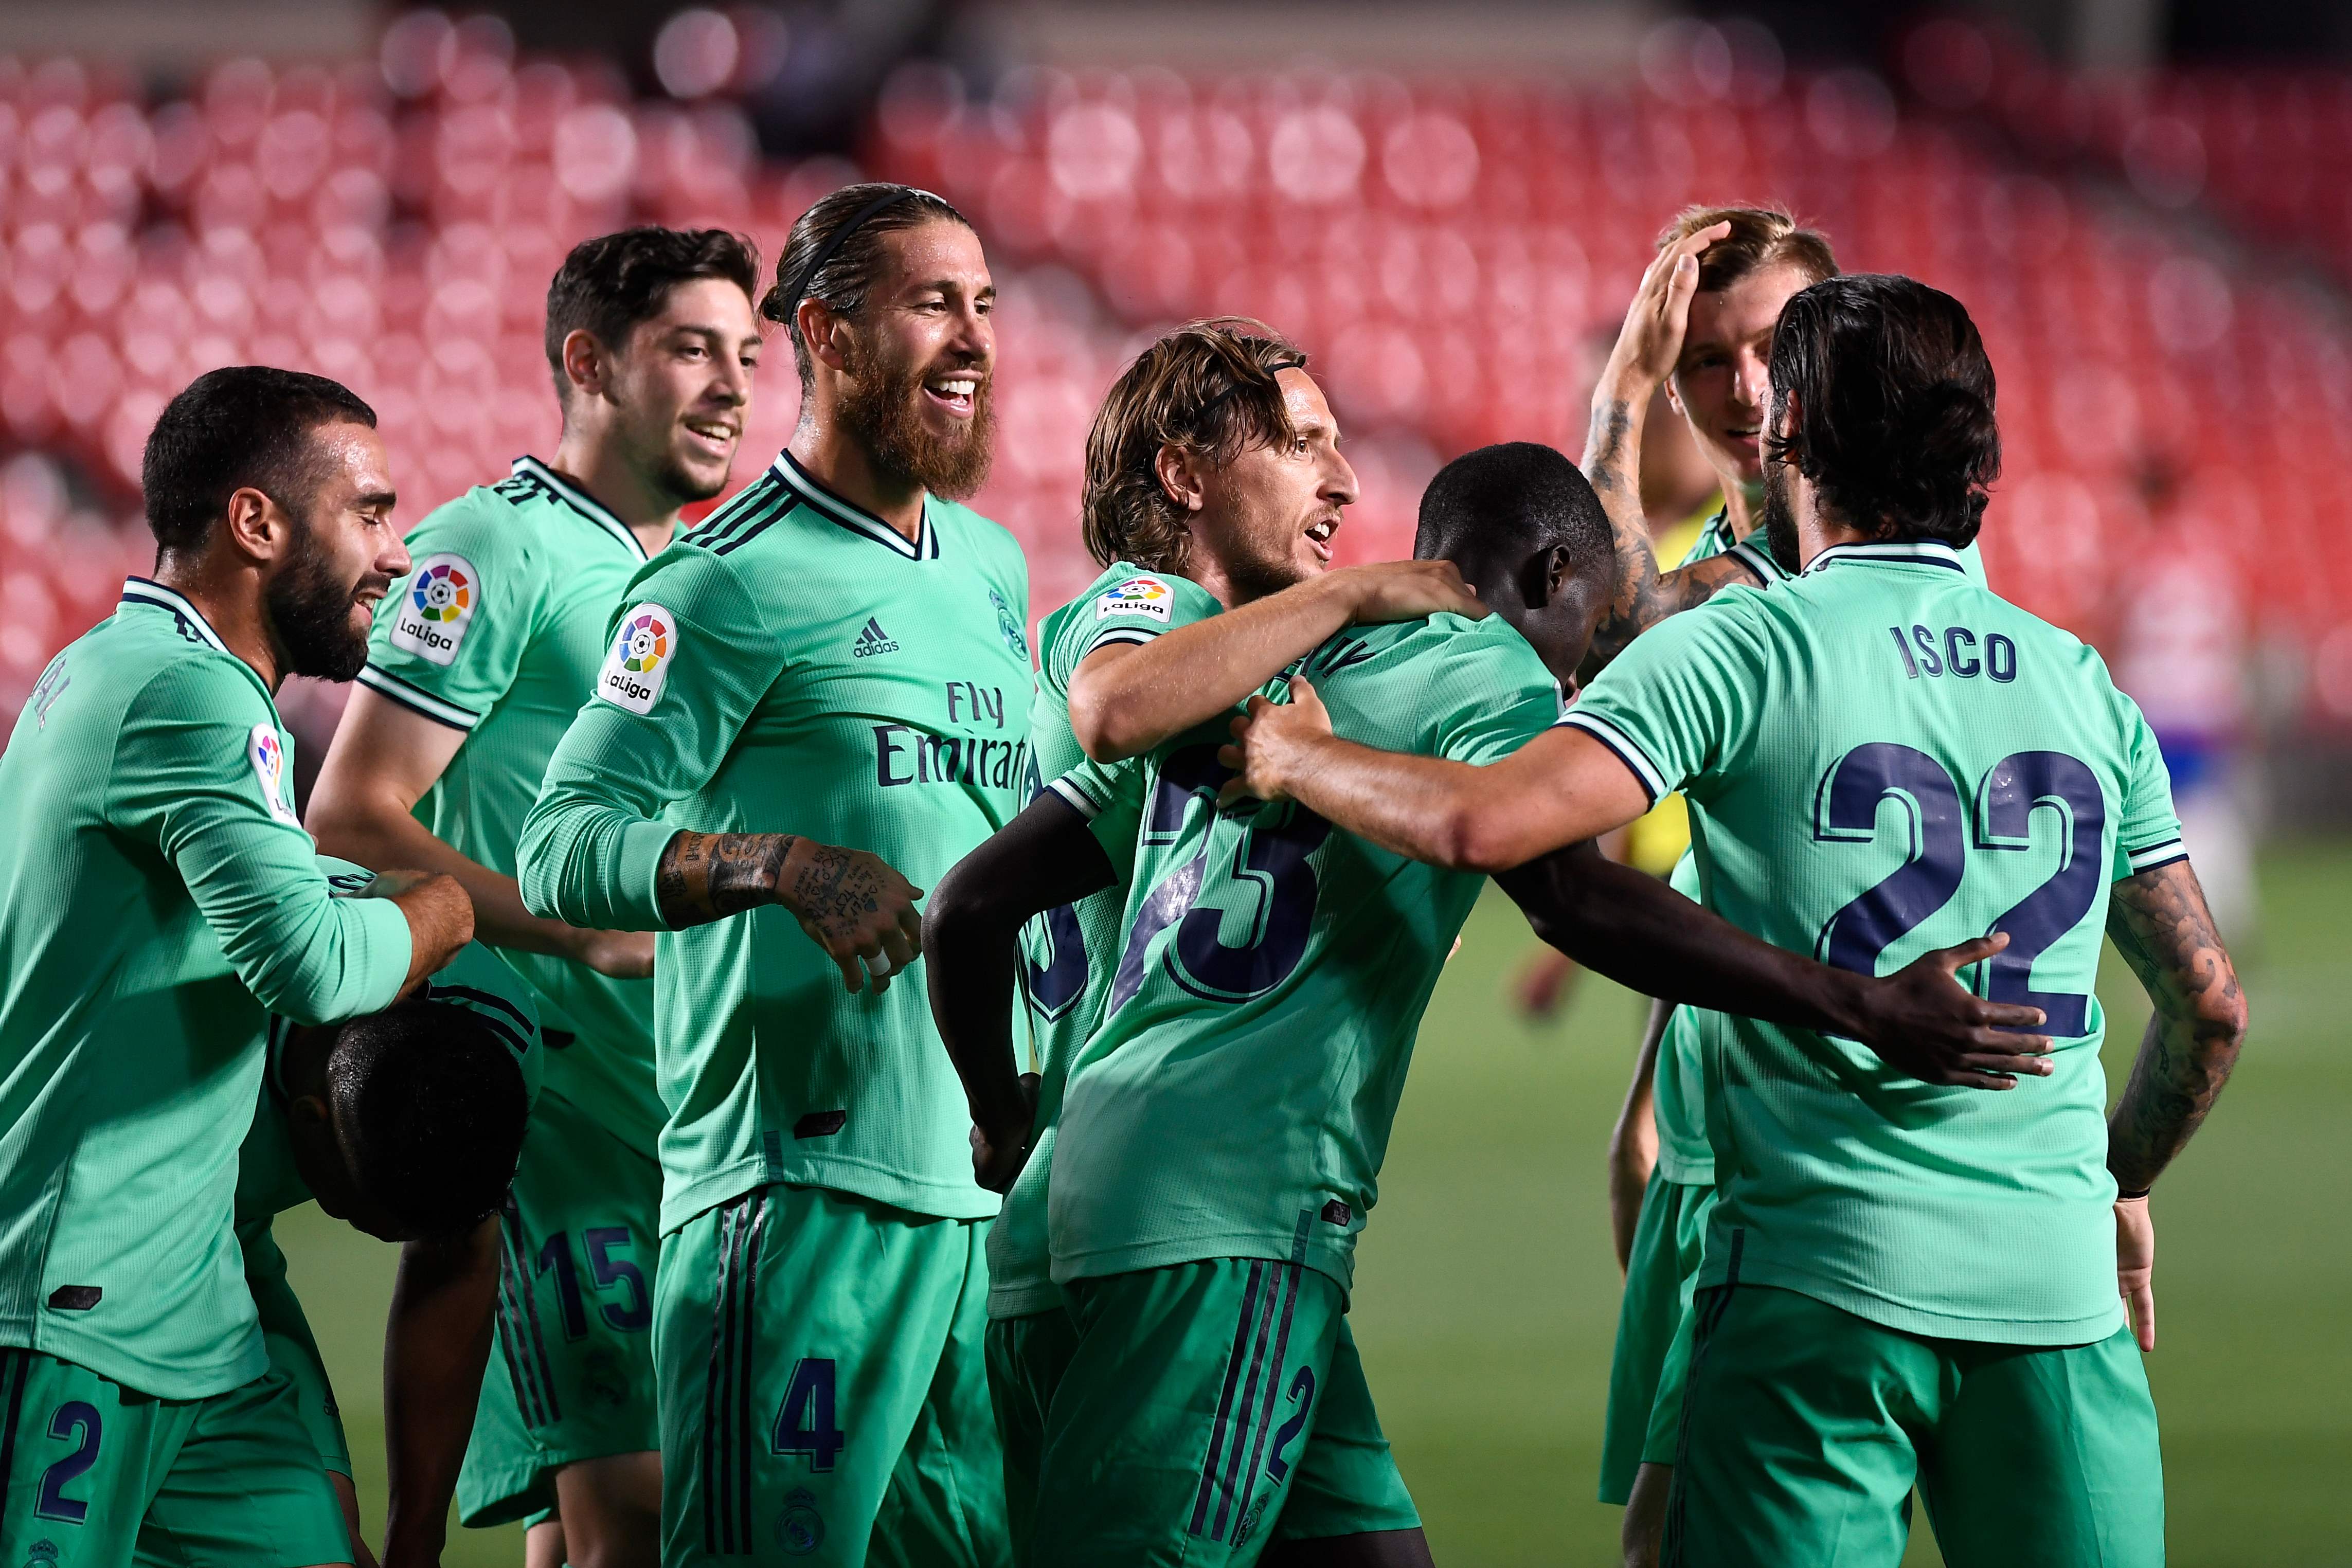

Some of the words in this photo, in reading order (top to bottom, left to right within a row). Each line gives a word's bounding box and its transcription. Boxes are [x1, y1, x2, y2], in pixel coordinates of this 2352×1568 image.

[401, 618, 453, 651] LaLiga
[1104, 602, 1163, 614] LaLiga
[854, 641, 899, 658] adidas
[1889, 624, 2016, 683] ISCO
[605, 670, 651, 700] LaLiga
[946, 681, 1003, 729] Fly
[872, 724, 1026, 789] Emirat
[1814, 742, 2105, 1038] 22
[535, 1227, 652, 1344] 15
[771, 1358, 844, 1473] 4
[1265, 1365, 1317, 1488] 2
[33, 1400, 102, 1525] 2
